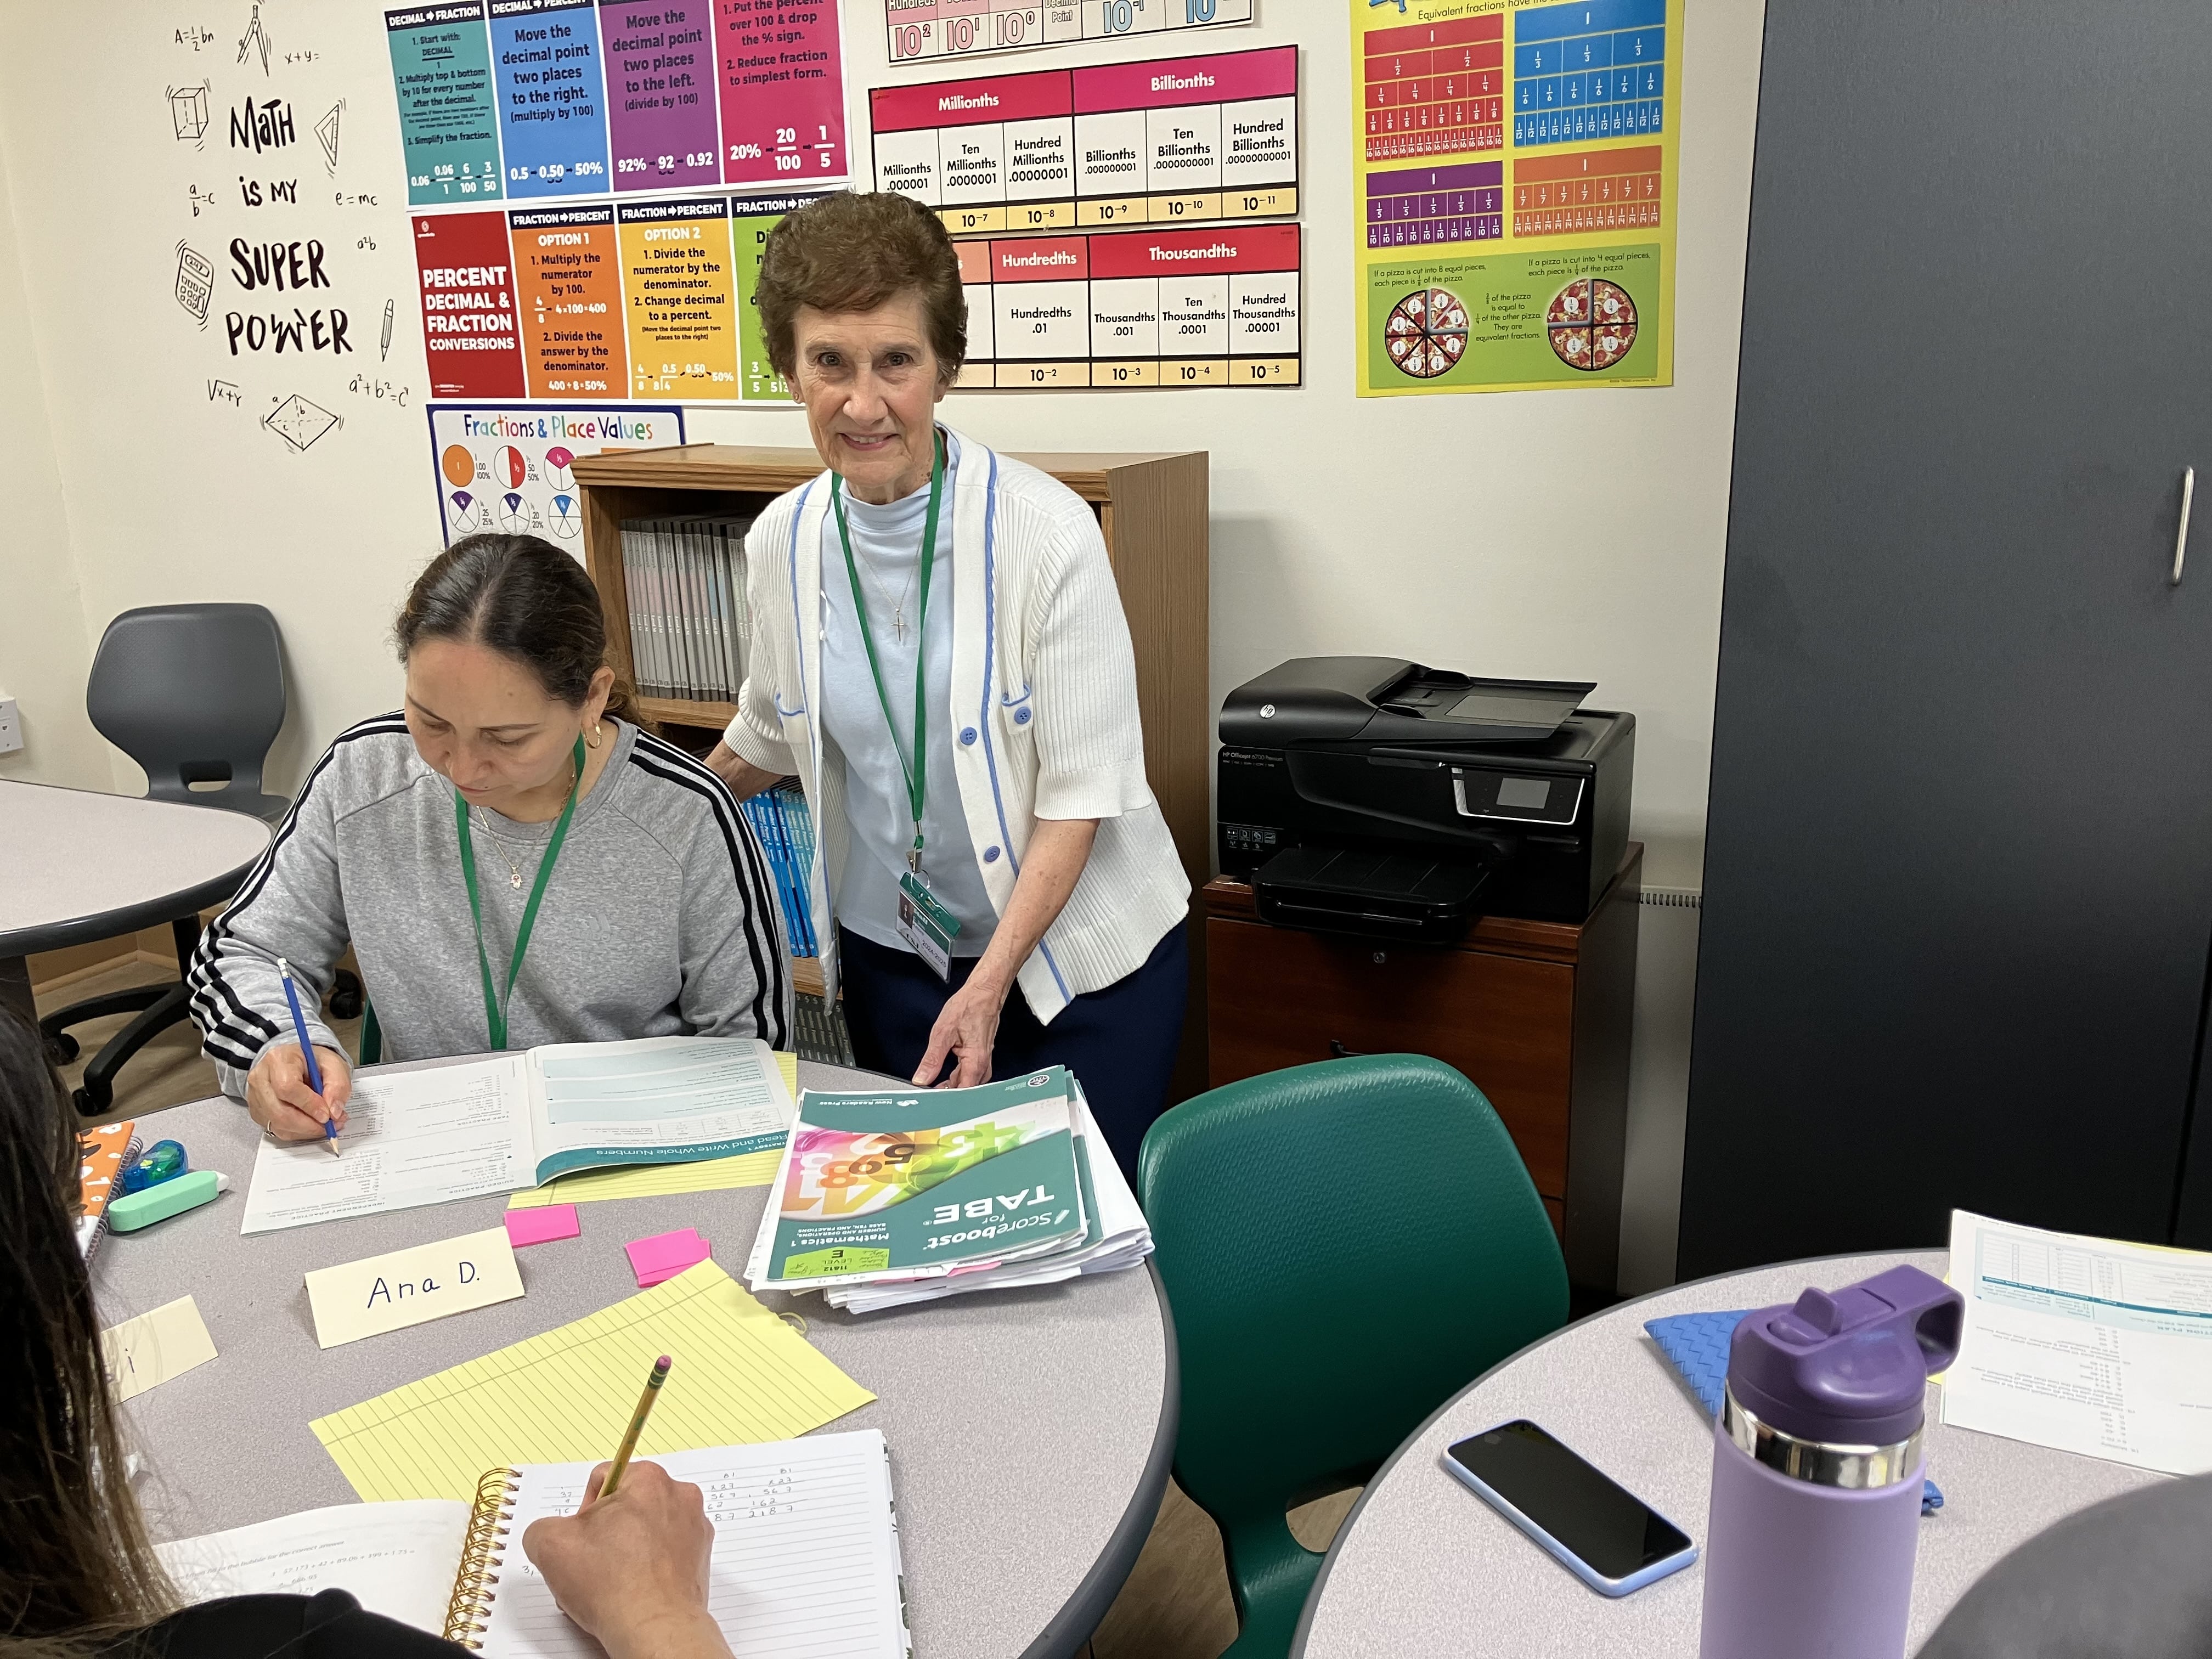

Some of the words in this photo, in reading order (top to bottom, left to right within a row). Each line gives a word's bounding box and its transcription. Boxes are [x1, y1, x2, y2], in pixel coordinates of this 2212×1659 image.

[493, 1, 532, 14] DECIMAL
[1418, 7, 1464, 21] Equivalent
[1466, 1, 1504, 13] fractions
[390, 13, 425, 26] DECIMAL
[436, 7, 480, 20] FRACTION
[626, 15, 660, 28] Move
[664, 10, 685, 24] the
[730, 20, 751, 30] over
[755, 16, 774, 26] 100
[778, 16, 785, 25] &
[788, 13, 817, 26] drop
[1052, 10, 1073, 23] Point
[515, 29, 547, 42] Move
[550, 25, 571, 38] the
[613, 35, 664, 52] decimal
[669, 29, 702, 48] point
[742, 35, 759, 46] the
[762, 33, 774, 43] %
[777, 31, 805, 45] sign.
[503, 48, 551, 65] decimal
[556, 44, 589, 61] point
[738, 56, 776, 69] Reduce
[780, 51, 827, 64] fraction
[624, 60, 649, 71] two
[653, 53, 694, 72] places
[515, 72, 538, 84] two
[543, 67, 582, 84] places
[730, 76, 740, 85] to
[743, 70, 790, 84] simplest
[794, 69, 826, 78] form.
[1150, 74, 1215, 91] Billionths
[626, 81, 639, 93] to
[644, 77, 664, 91] the
[669, 74, 695, 88] left.
[512, 93, 526, 104] to
[530, 90, 550, 103] the
[554, 86, 588, 106] right.
[625, 97, 659, 111] (divide
[663, 95, 675, 108] by
[678, 92, 698, 105] 100)
[939, 94, 999, 111] Millionths
[511, 109, 555, 122] (multiply
[558, 108, 569, 119] by
[573, 104, 594, 116] 100)
[1173, 128, 1194, 139] Ten
[1233, 120, 1284, 134] Hundred
[962, 144, 980, 154] Ten
[1015, 136, 1061, 149] Hundred
[1158, 142, 1211, 157] Billionths
[1233, 137, 1285, 153] Billionths
[730, 144, 761, 160] 20%
[1086, 149, 1136, 163] Billionths
[618, 159, 647, 172] 92%
[658, 155, 674, 169] 92
[687, 152, 713, 167] 0.92
[947, 156, 996, 172] Millionths
[1013, 153, 1064, 167] Millionths
[511, 167, 528, 179] 0.5
[539, 165, 564, 178] 0.50
[575, 162, 603, 176] 50%
[883, 162, 932, 177] Millionths
[514, 214, 559, 225] FRACTION
[569, 211, 610, 222] PERCENT
[622, 208, 667, 219] FRACTION
[677, 204, 723, 216] PERCENT
[538, 234, 581, 246] OPTION
[584, 233, 589, 244] 1
[645, 228, 690, 241] OPTION
[693, 227, 701, 239] 2
[541, 255, 581, 266] Multiply
[584, 254, 600, 263] the
[1003, 253, 1077, 268] Hundredths
[1149, 245, 1237, 262] Thousandths
[230, 238, 330, 291] SUPER
[423, 266, 507, 288] PERCENT
[541, 270, 592, 280] numerator
[644, 279, 711, 289] denominator.
[426, 292, 494, 311] DECIMAL
[499, 292, 510, 308] &
[645, 296, 681, 307] Change
[685, 294, 724, 304] decimal
[1185, 297, 1203, 307] Ten
[1243, 294, 1286, 305] Hundred
[650, 312, 659, 320] to
[671, 311, 712, 321] percent.
[1011, 307, 1071, 319] Hundredths
[1094, 312, 1155, 324] Thousandths
[1163, 309, 1226, 321] Thousandths
[1233, 308, 1295, 319] Thousandths
[427, 314, 512, 332] FRACTION
[1032, 323, 1047, 334] .01
[1494, 324, 1510, 332] They
[226, 309, 353, 356] POWER
[430, 337, 515, 351] CONVERSIONS
[544, 362, 608, 371] denominator.
[464, 414, 534, 437] Fractions
[538, 419, 547, 437] &
[552, 415, 595, 438] Place
[598, 416, 653, 439] Values
[1262, 704, 1273, 718] hp
[657, 1145, 695, 1155] Whole
[698, 1142, 729, 1153] Write
[732, 1138, 754, 1148] and
[595, 1147, 653, 1157] Numbers
[982, 1214, 1005, 1225] for
[800, 1233, 889, 1245] Mathematics
[832, 1249, 844, 1257] E
[368, 1277, 441, 1309] Ana
[460, 1262, 480, 1284] D.
